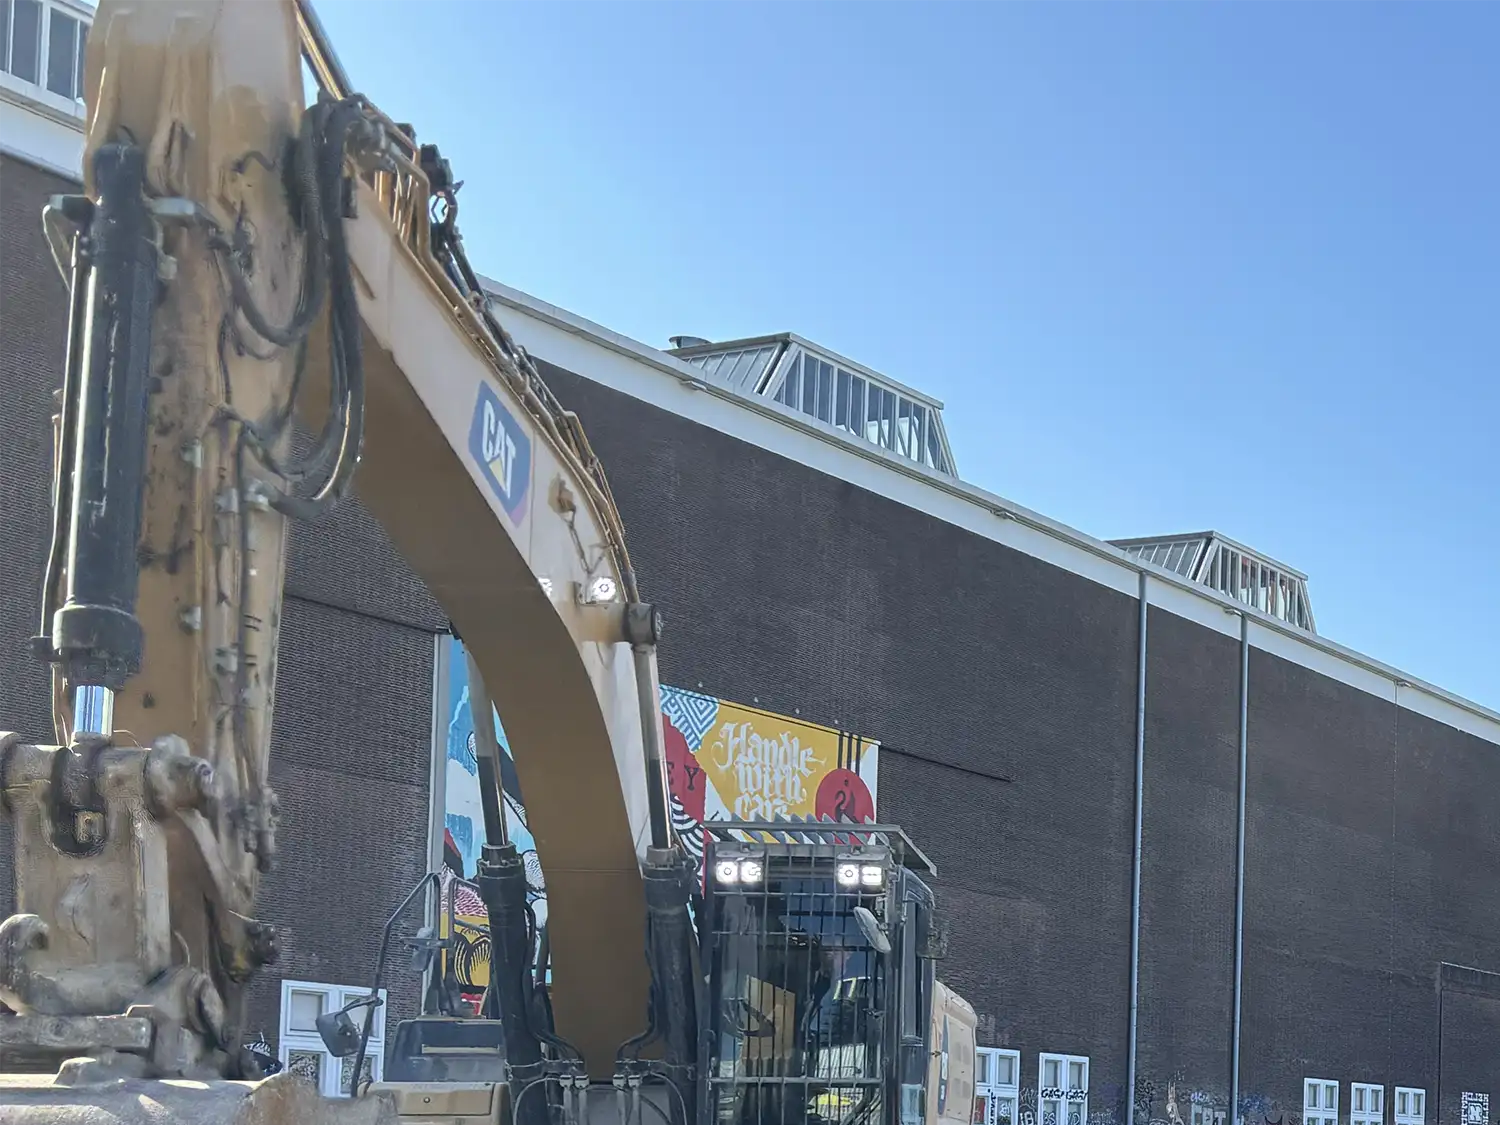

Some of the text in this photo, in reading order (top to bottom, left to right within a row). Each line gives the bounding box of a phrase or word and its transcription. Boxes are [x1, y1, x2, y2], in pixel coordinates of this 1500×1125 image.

[482, 399, 516, 499] CAT
[711, 722, 827, 778] Handle
[733, 759, 807, 804] with
[734, 793, 794, 822] care
